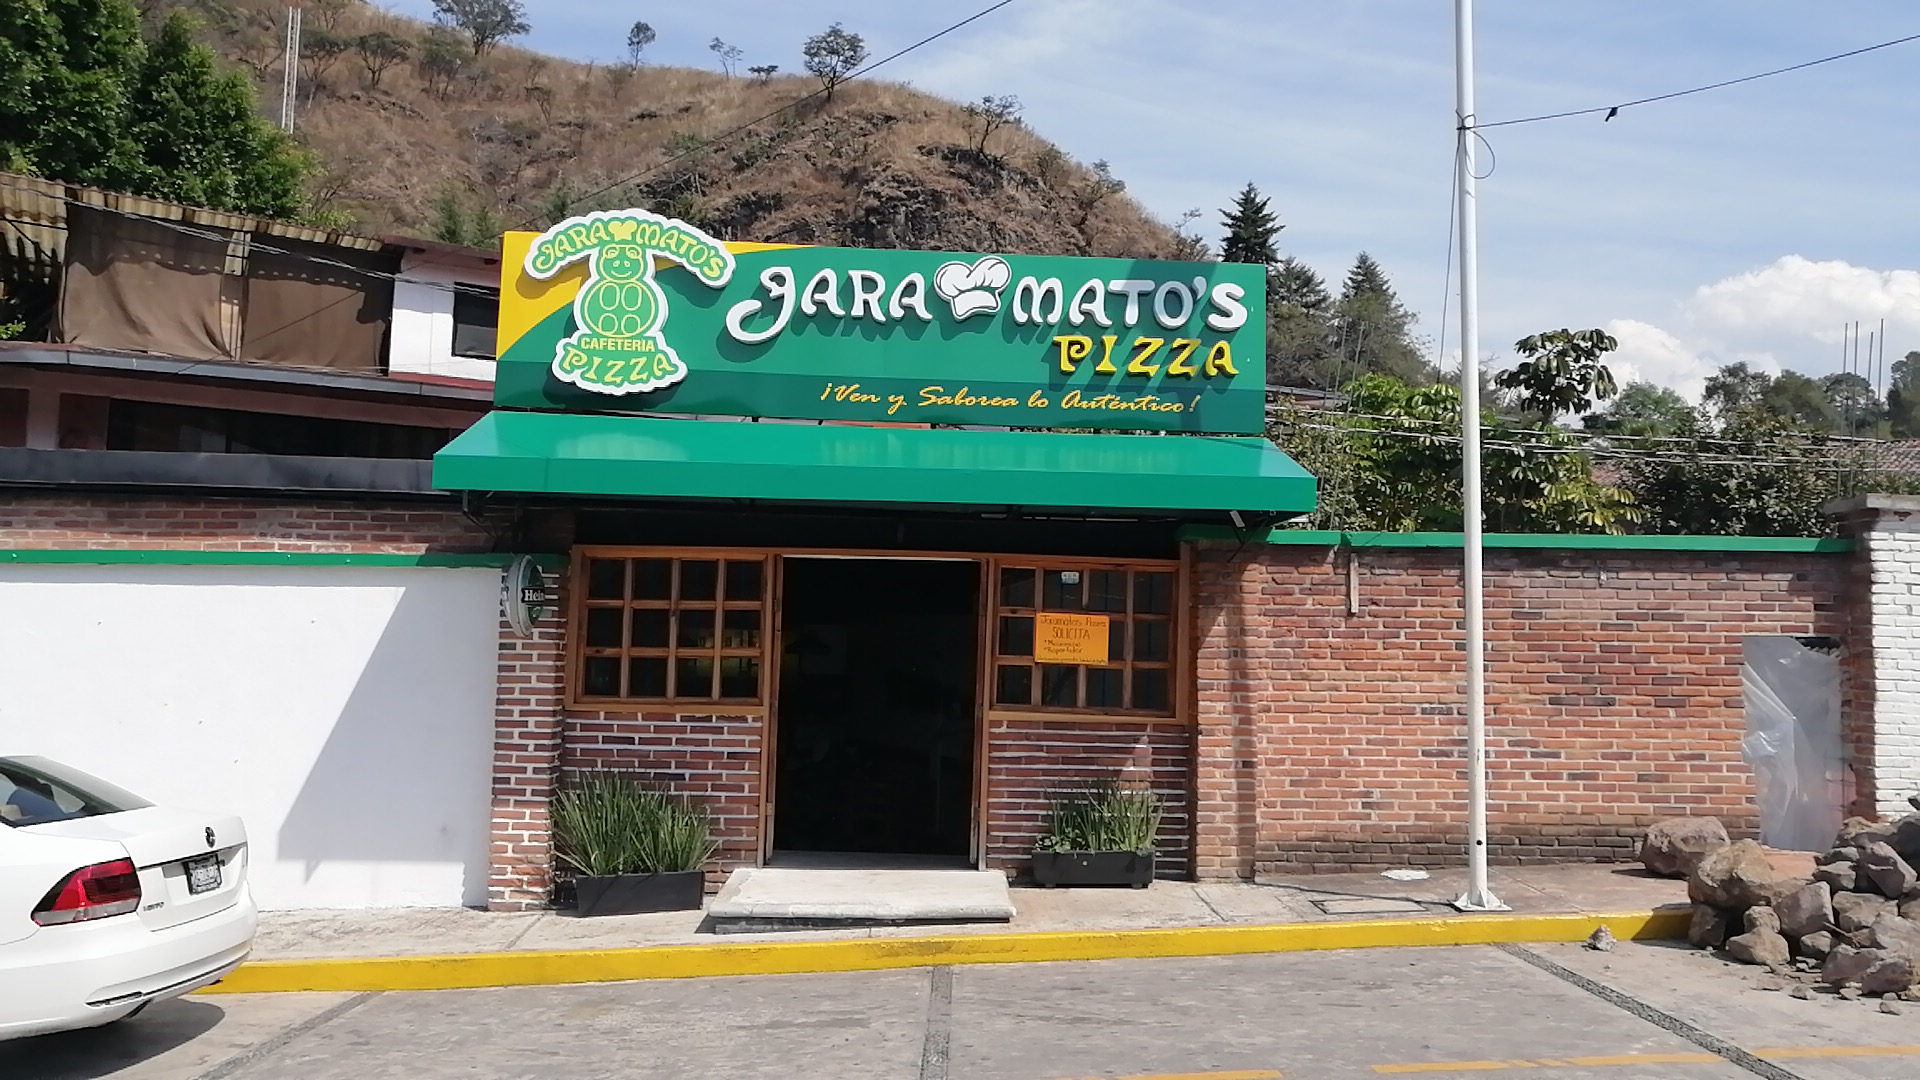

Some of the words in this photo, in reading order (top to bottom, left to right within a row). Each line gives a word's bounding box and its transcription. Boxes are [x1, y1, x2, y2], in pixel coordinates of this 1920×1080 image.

[726, 265, 933, 343] JARA
[1013, 275, 1249, 331] MATO'S
[580, 337, 655, 352] CAFETERIA
[1053, 335, 1239, 377] PIZZA
[562, 347, 674, 384] PIZZA
[887, 394, 908, 415] y
[917, 385, 1020, 407] Saborea
[1027, 389, 1050, 408] lo
[1052, 626, 1091, 640] SOLICITA
